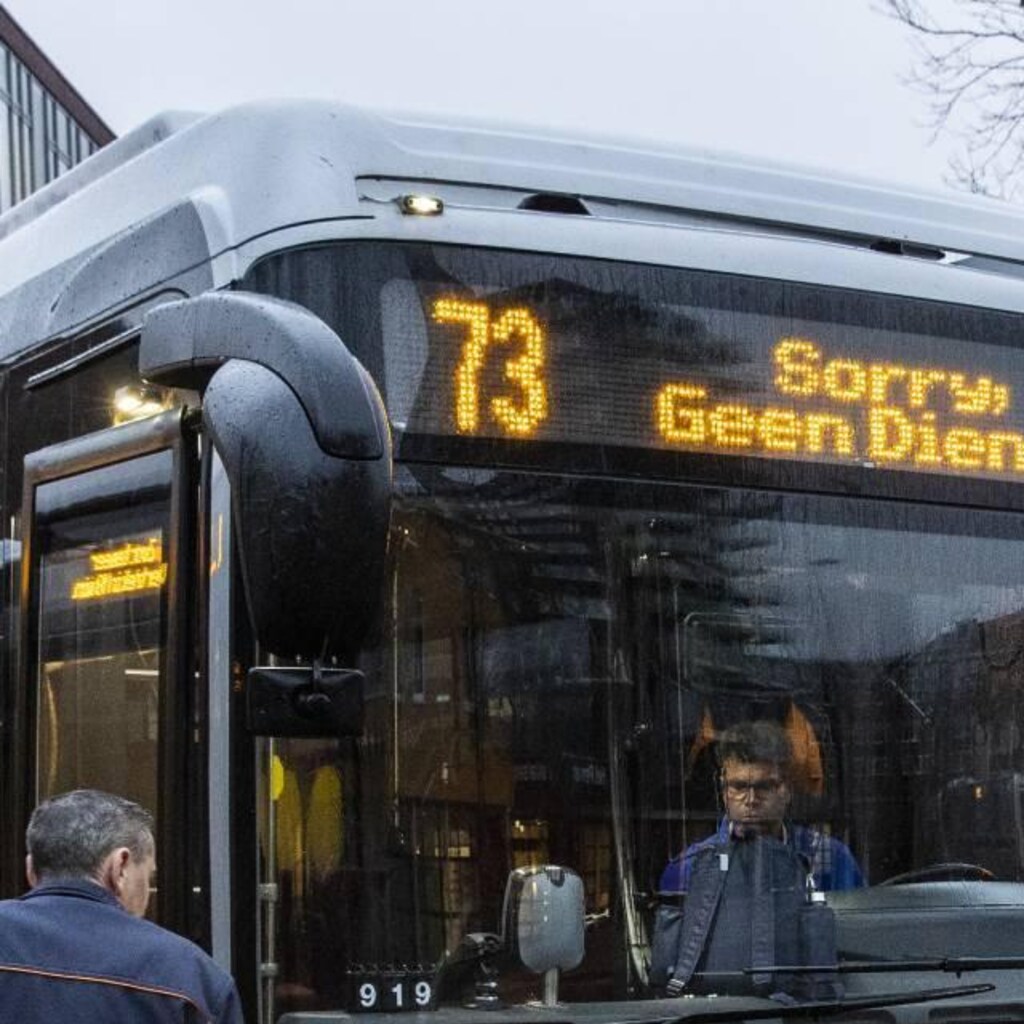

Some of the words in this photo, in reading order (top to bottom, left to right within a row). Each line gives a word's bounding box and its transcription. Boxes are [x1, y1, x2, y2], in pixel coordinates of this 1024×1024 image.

[432, 299, 546, 436] 73
[773, 338, 1008, 414] Sorry,
[657, 382, 853, 455] Geen
